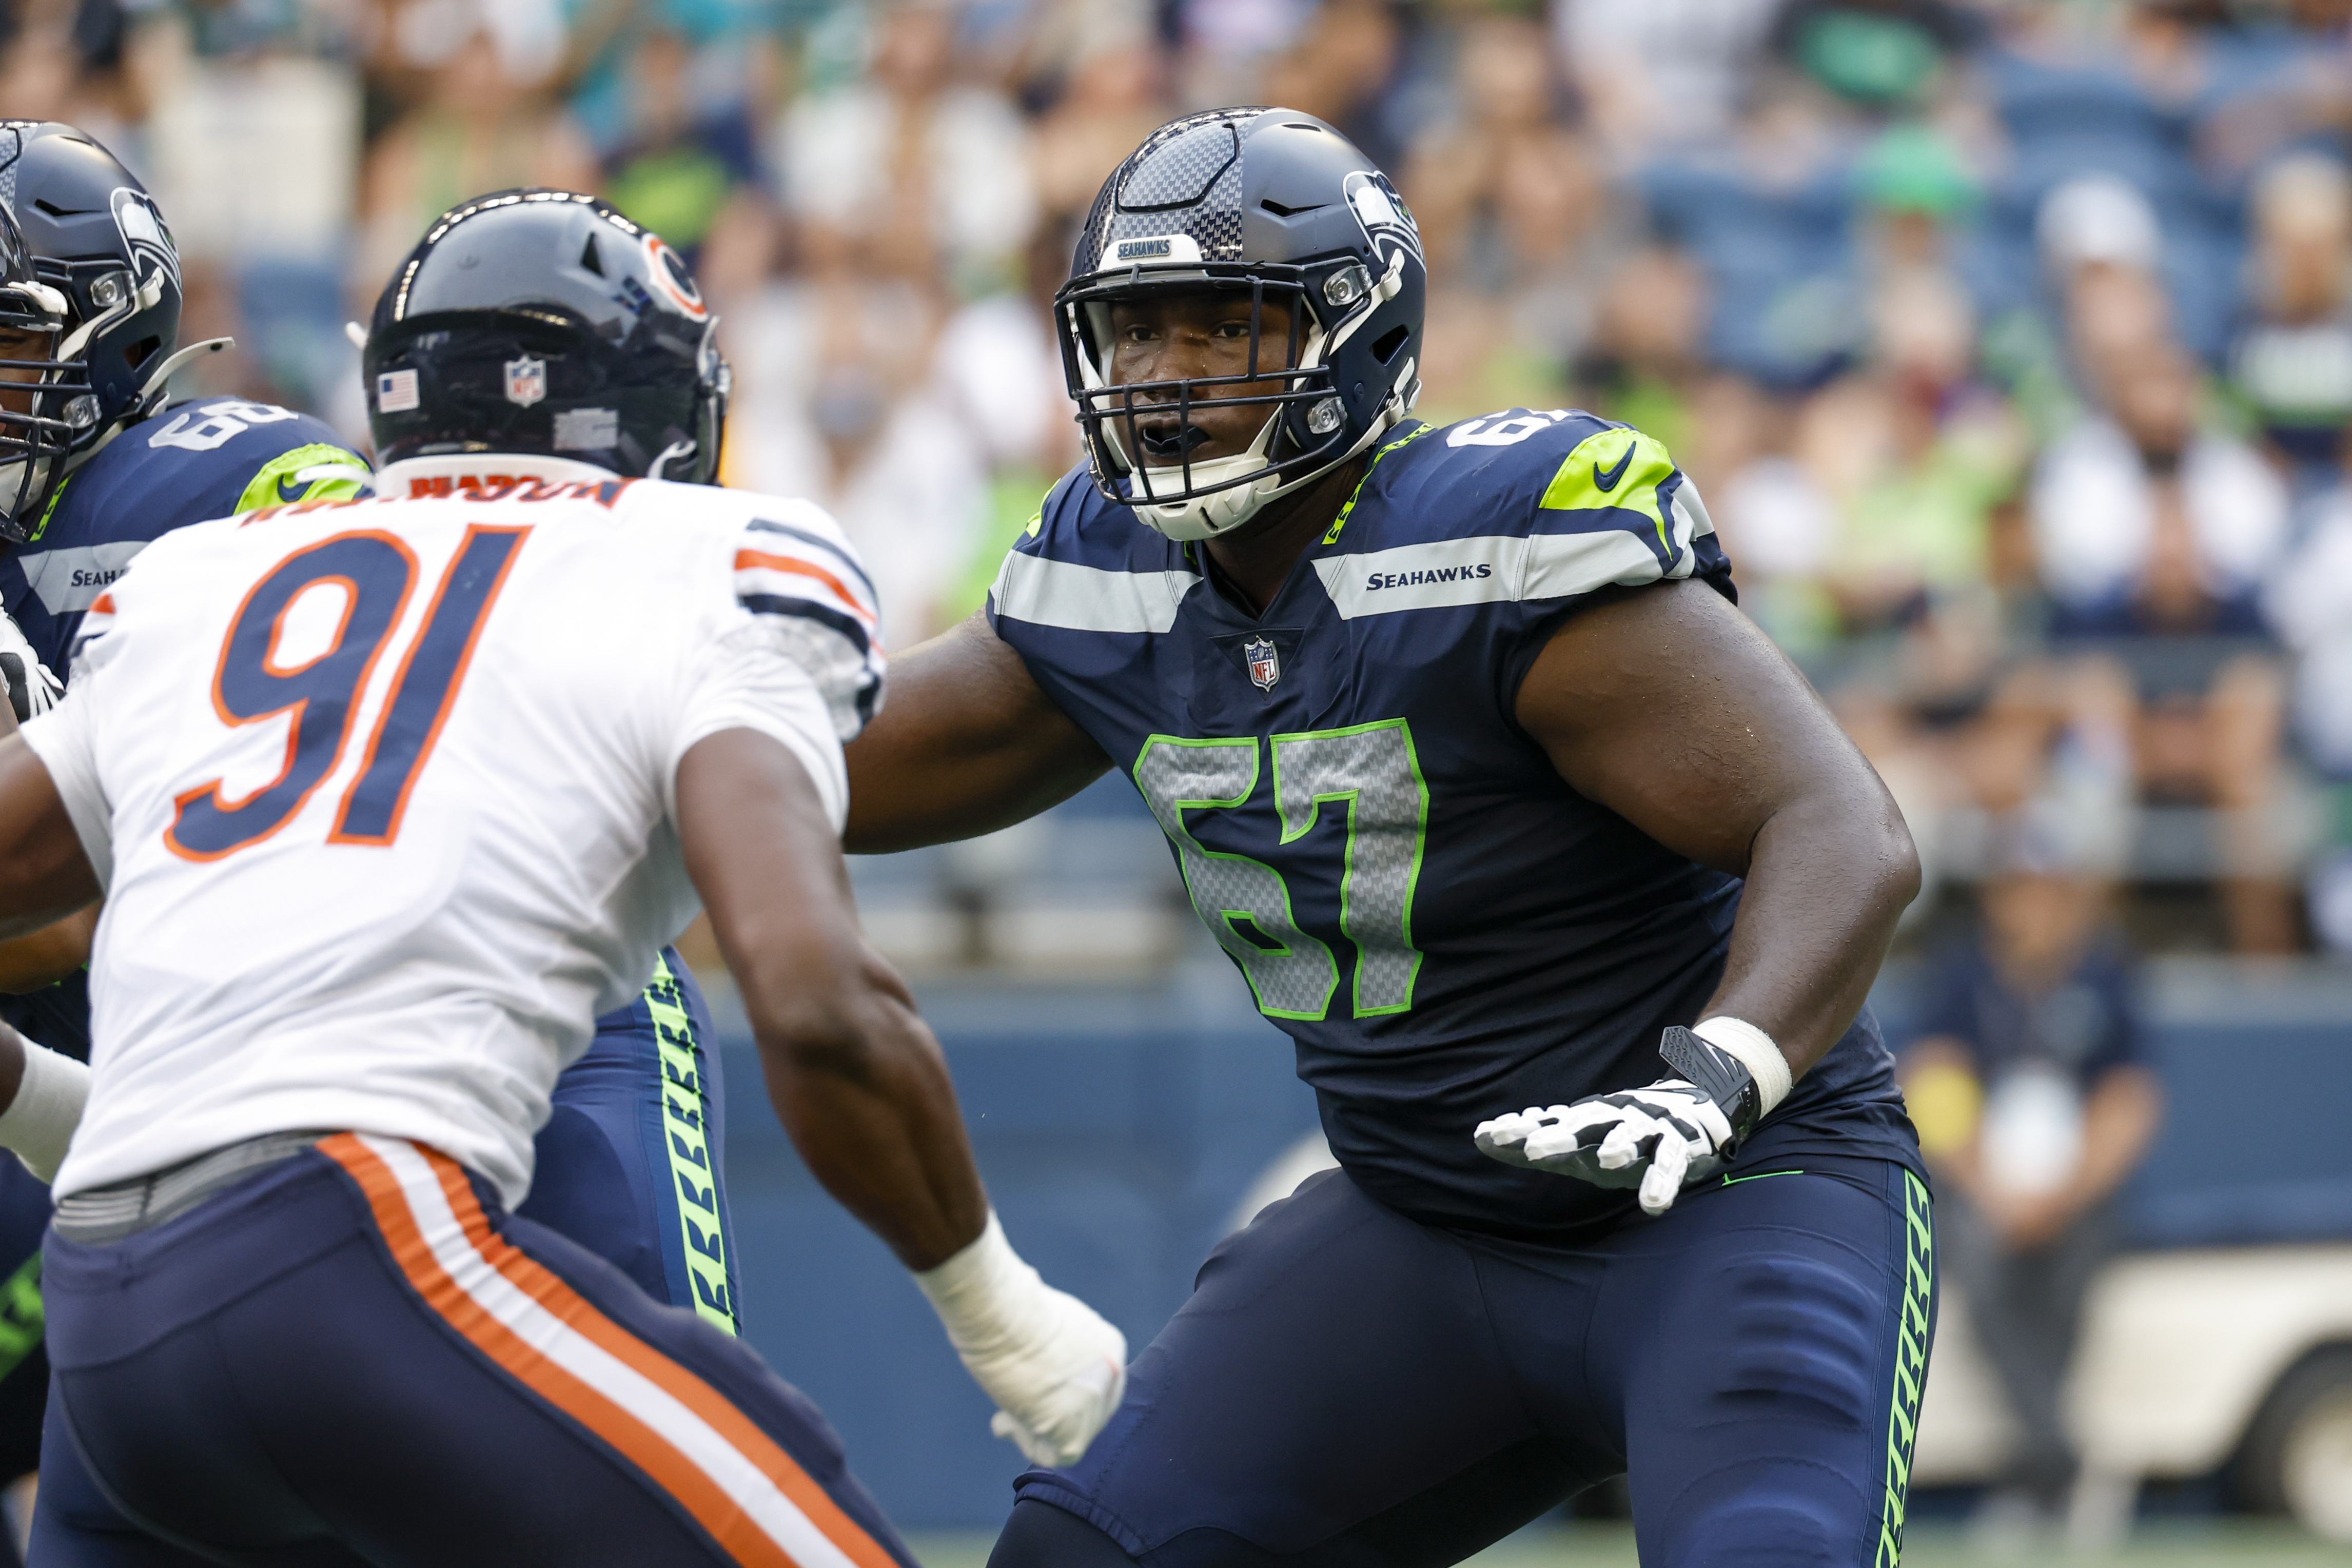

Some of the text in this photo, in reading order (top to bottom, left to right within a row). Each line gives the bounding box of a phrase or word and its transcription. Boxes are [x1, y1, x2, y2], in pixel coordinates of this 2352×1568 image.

[1118, 240, 1170, 258] SEAHAWKS
[1366, 564, 1492, 591] SEAHAWKS
[1252, 661, 1275, 682] NFL
[163, 523, 536, 863] 91
[1132, 717, 1429, 1021] 67
